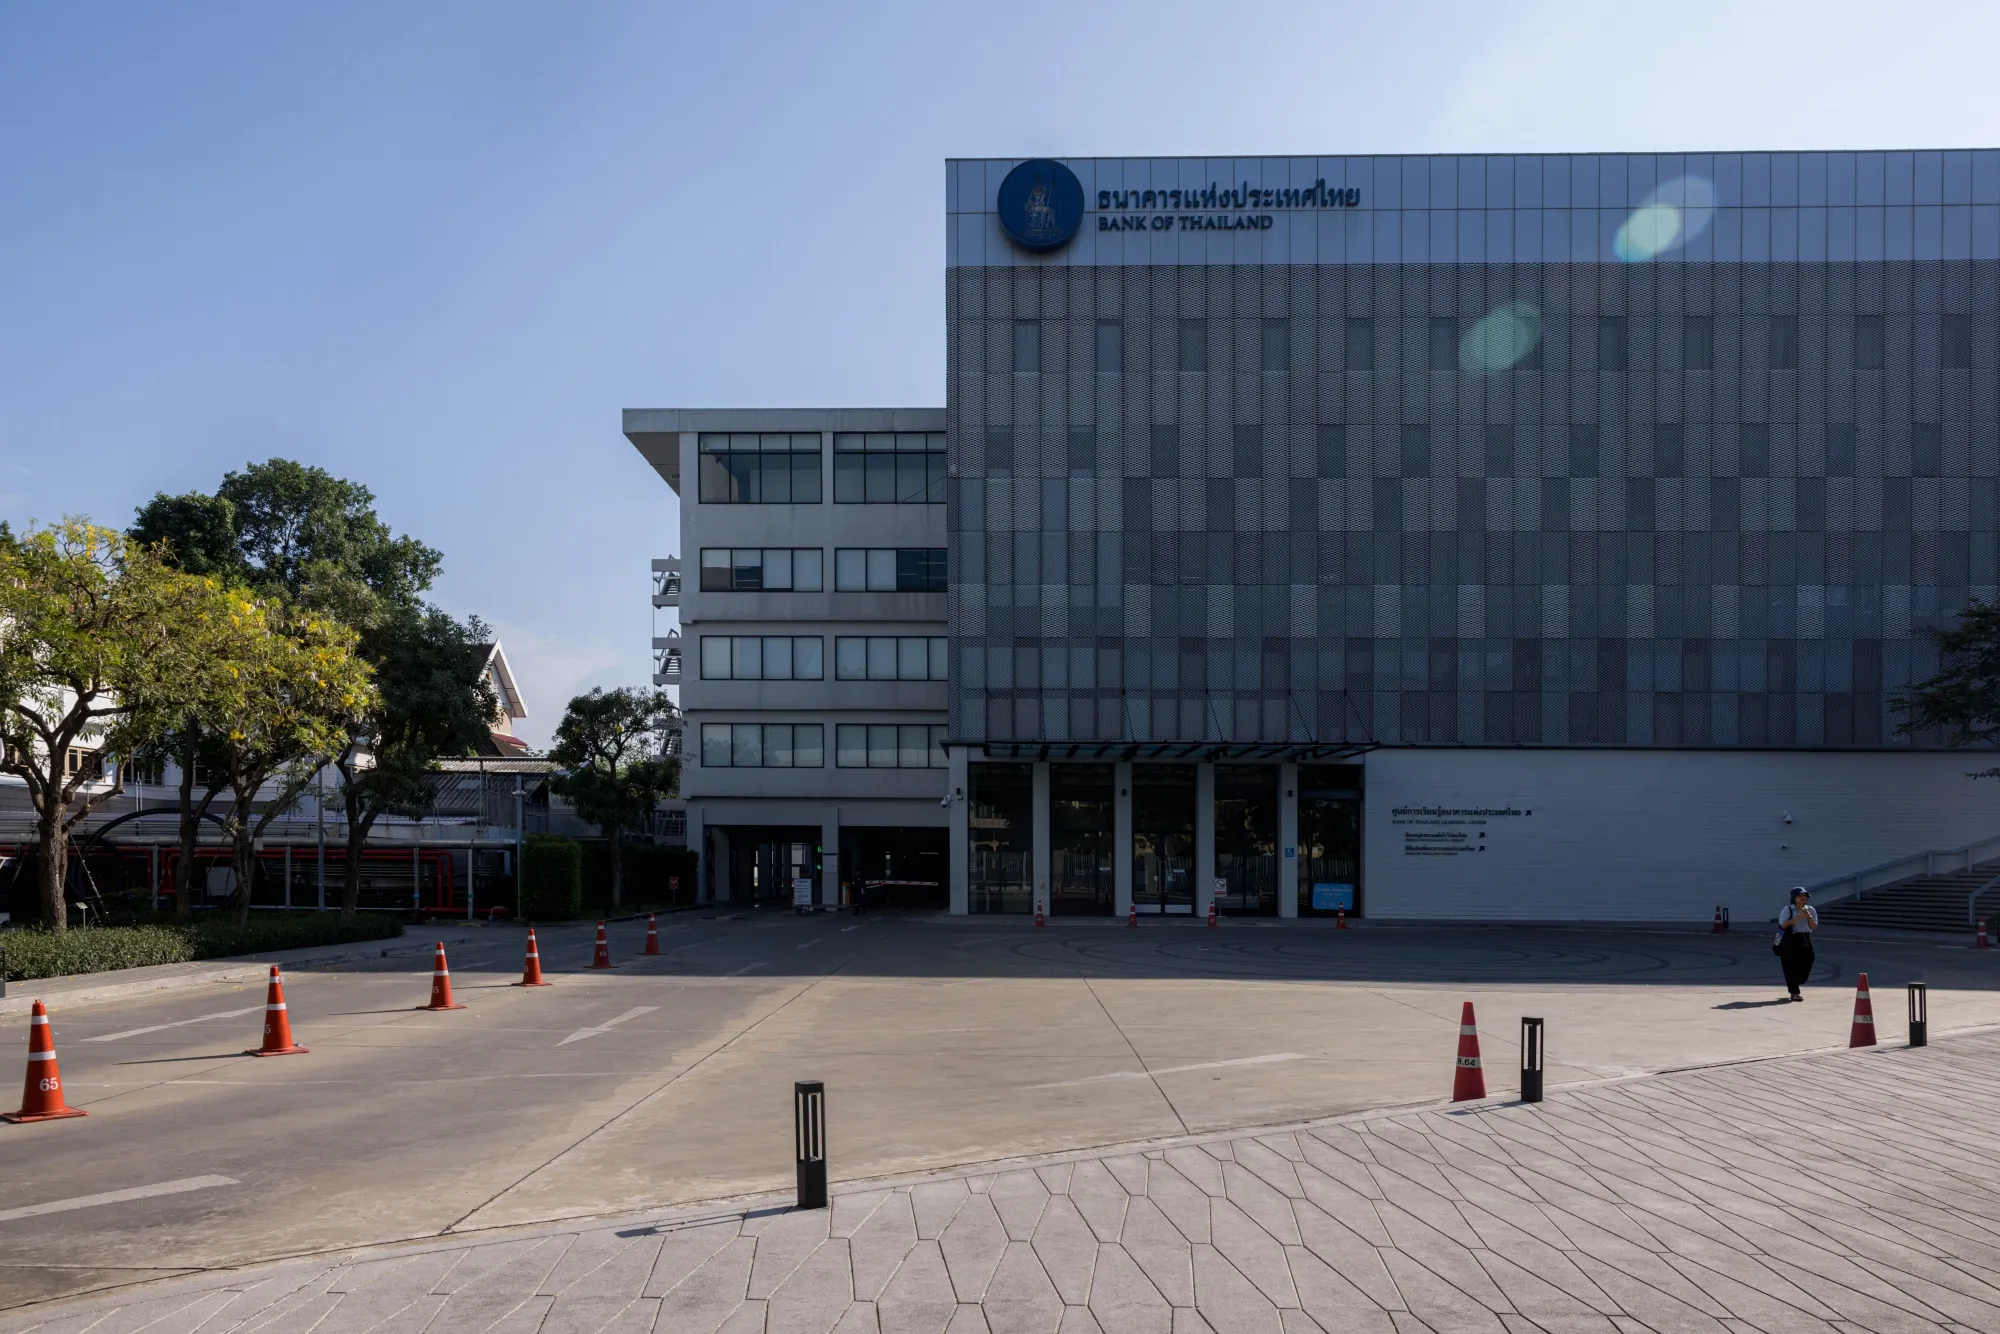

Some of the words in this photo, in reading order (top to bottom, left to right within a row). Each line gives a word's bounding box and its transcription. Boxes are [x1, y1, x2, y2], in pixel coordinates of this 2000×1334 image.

[1098, 178, 1360, 209] ธนาคารแห่งประเทศไทย
[1099, 216, 1147, 231] BANK
[1151, 216, 1174, 231] OF
[1179, 215, 1274, 231] THAILAND
[39, 1077, 59, 1092] 65
